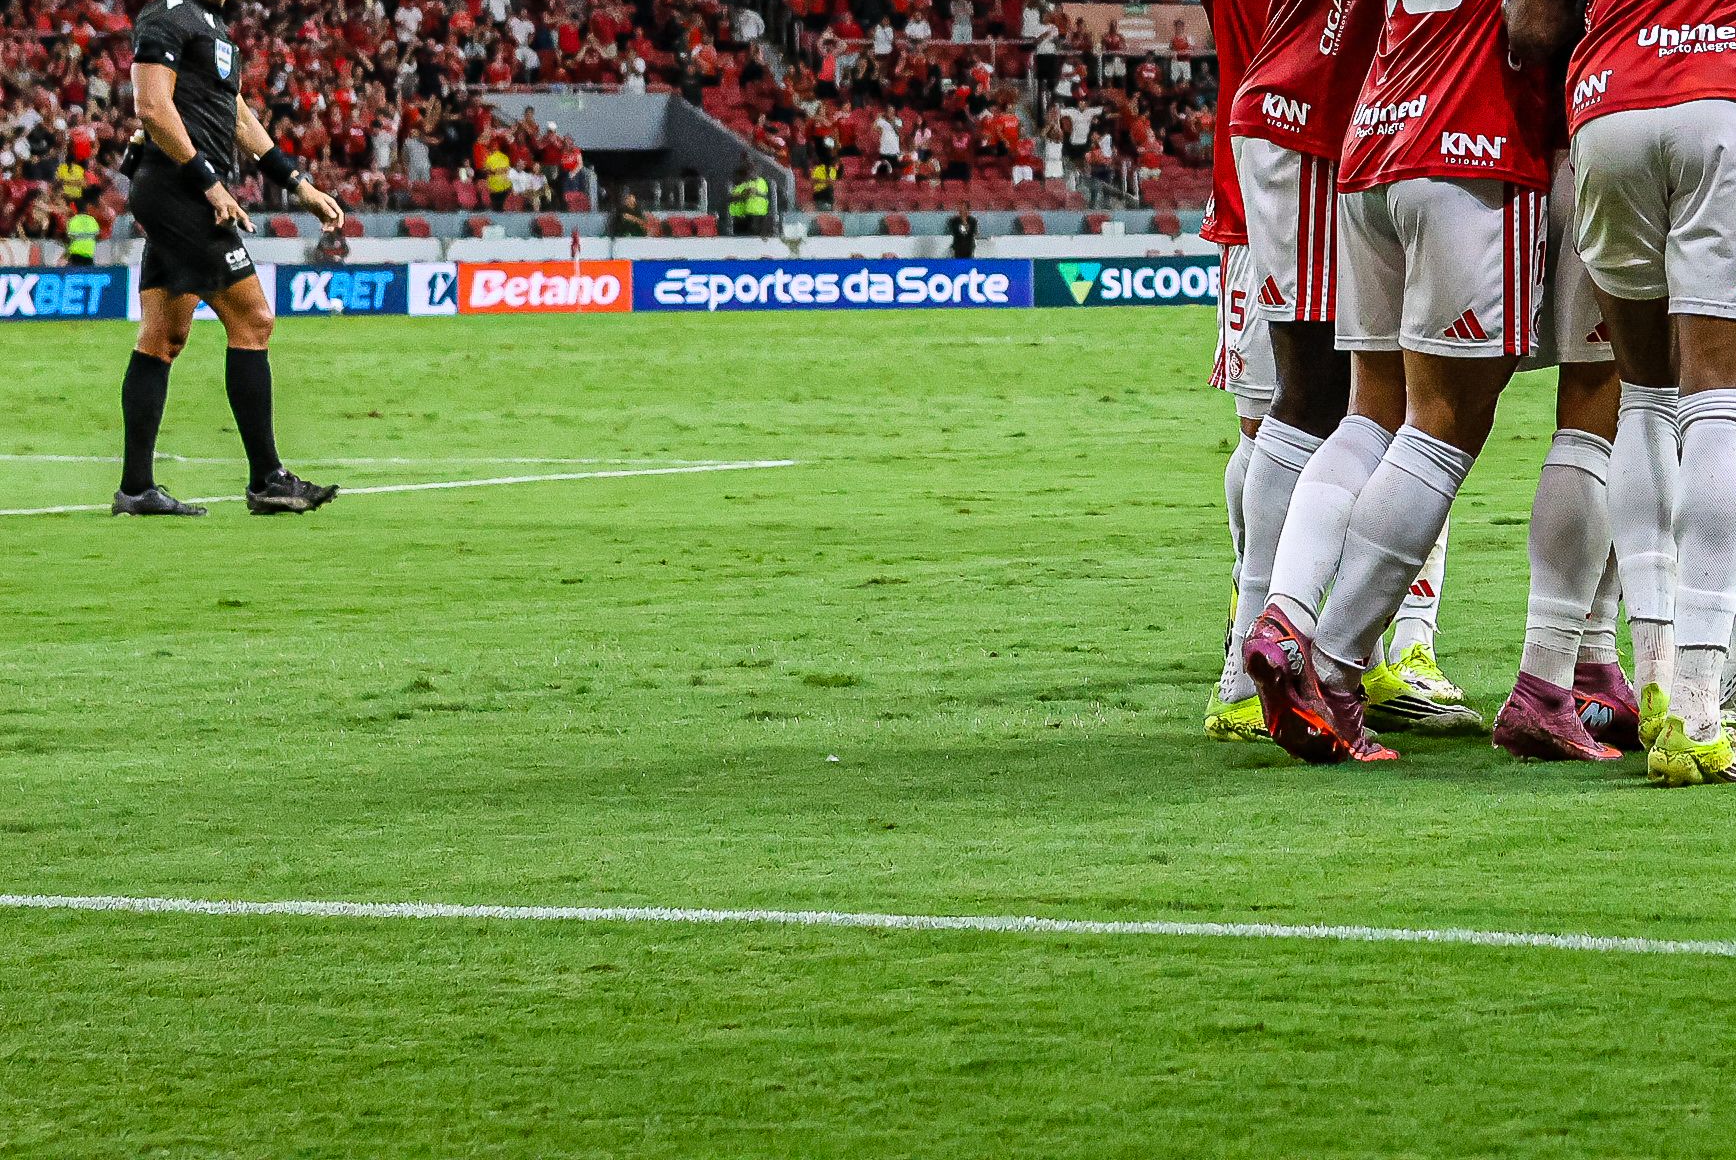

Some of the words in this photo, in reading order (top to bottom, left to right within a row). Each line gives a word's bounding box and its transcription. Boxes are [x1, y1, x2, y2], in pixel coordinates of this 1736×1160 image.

[1658, 40, 1692, 58] Porto
[1262, 92, 1308, 126] KNN
[1441, 131, 1502, 159] KNN
[1444, 157, 1495, 168] IDIOMAS
[290, 270, 394, 313] 1XBET
[469, 269, 621, 308] Betano
[653, 268, 840, 311] Esportes
[843, 269, 895, 303] da
[896, 266, 1010, 303] Sorte
[1229, 289, 1247, 332] 5
